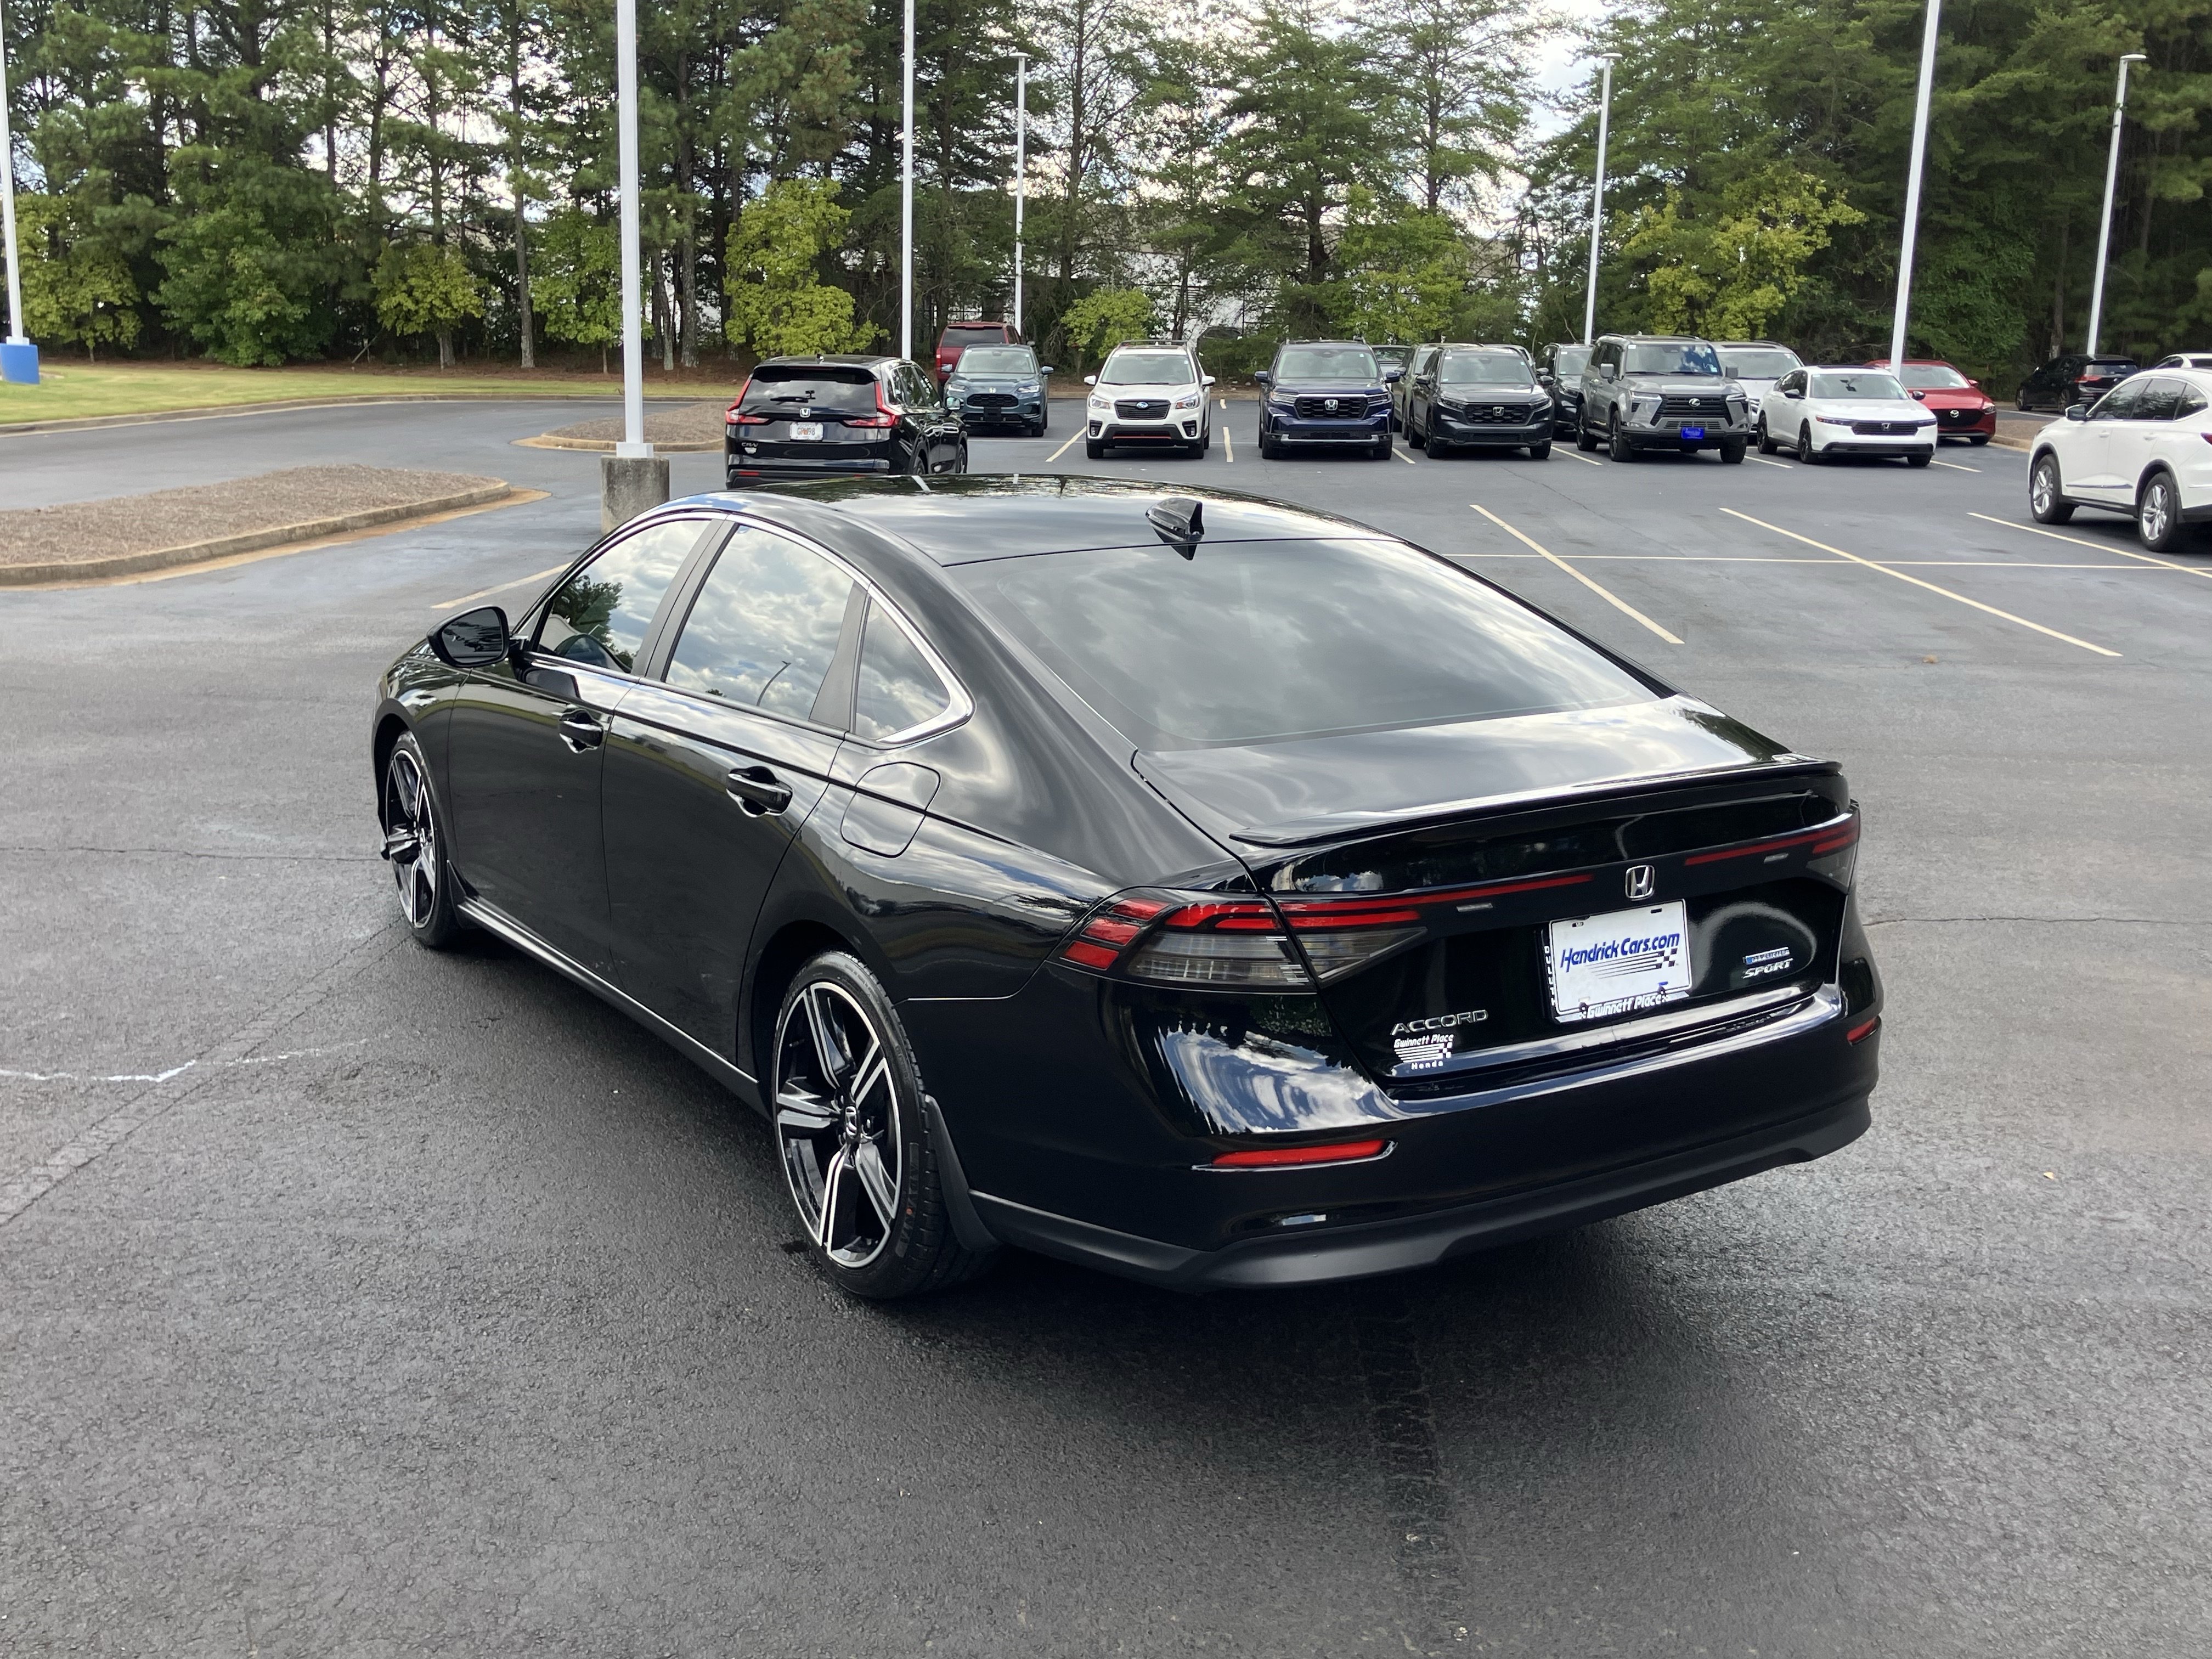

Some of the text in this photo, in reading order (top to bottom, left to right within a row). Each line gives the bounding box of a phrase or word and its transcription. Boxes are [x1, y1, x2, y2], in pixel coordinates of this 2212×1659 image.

[1742, 958, 1793, 979] SPORT
[1587, 994, 1663, 1019] Gwinnett Place
[1390, 1009, 1489, 1036] ACCORD
[1393, 1034, 1454, 1048] Gwinnett Place
[1410, 1060, 1444, 1070] Honda
